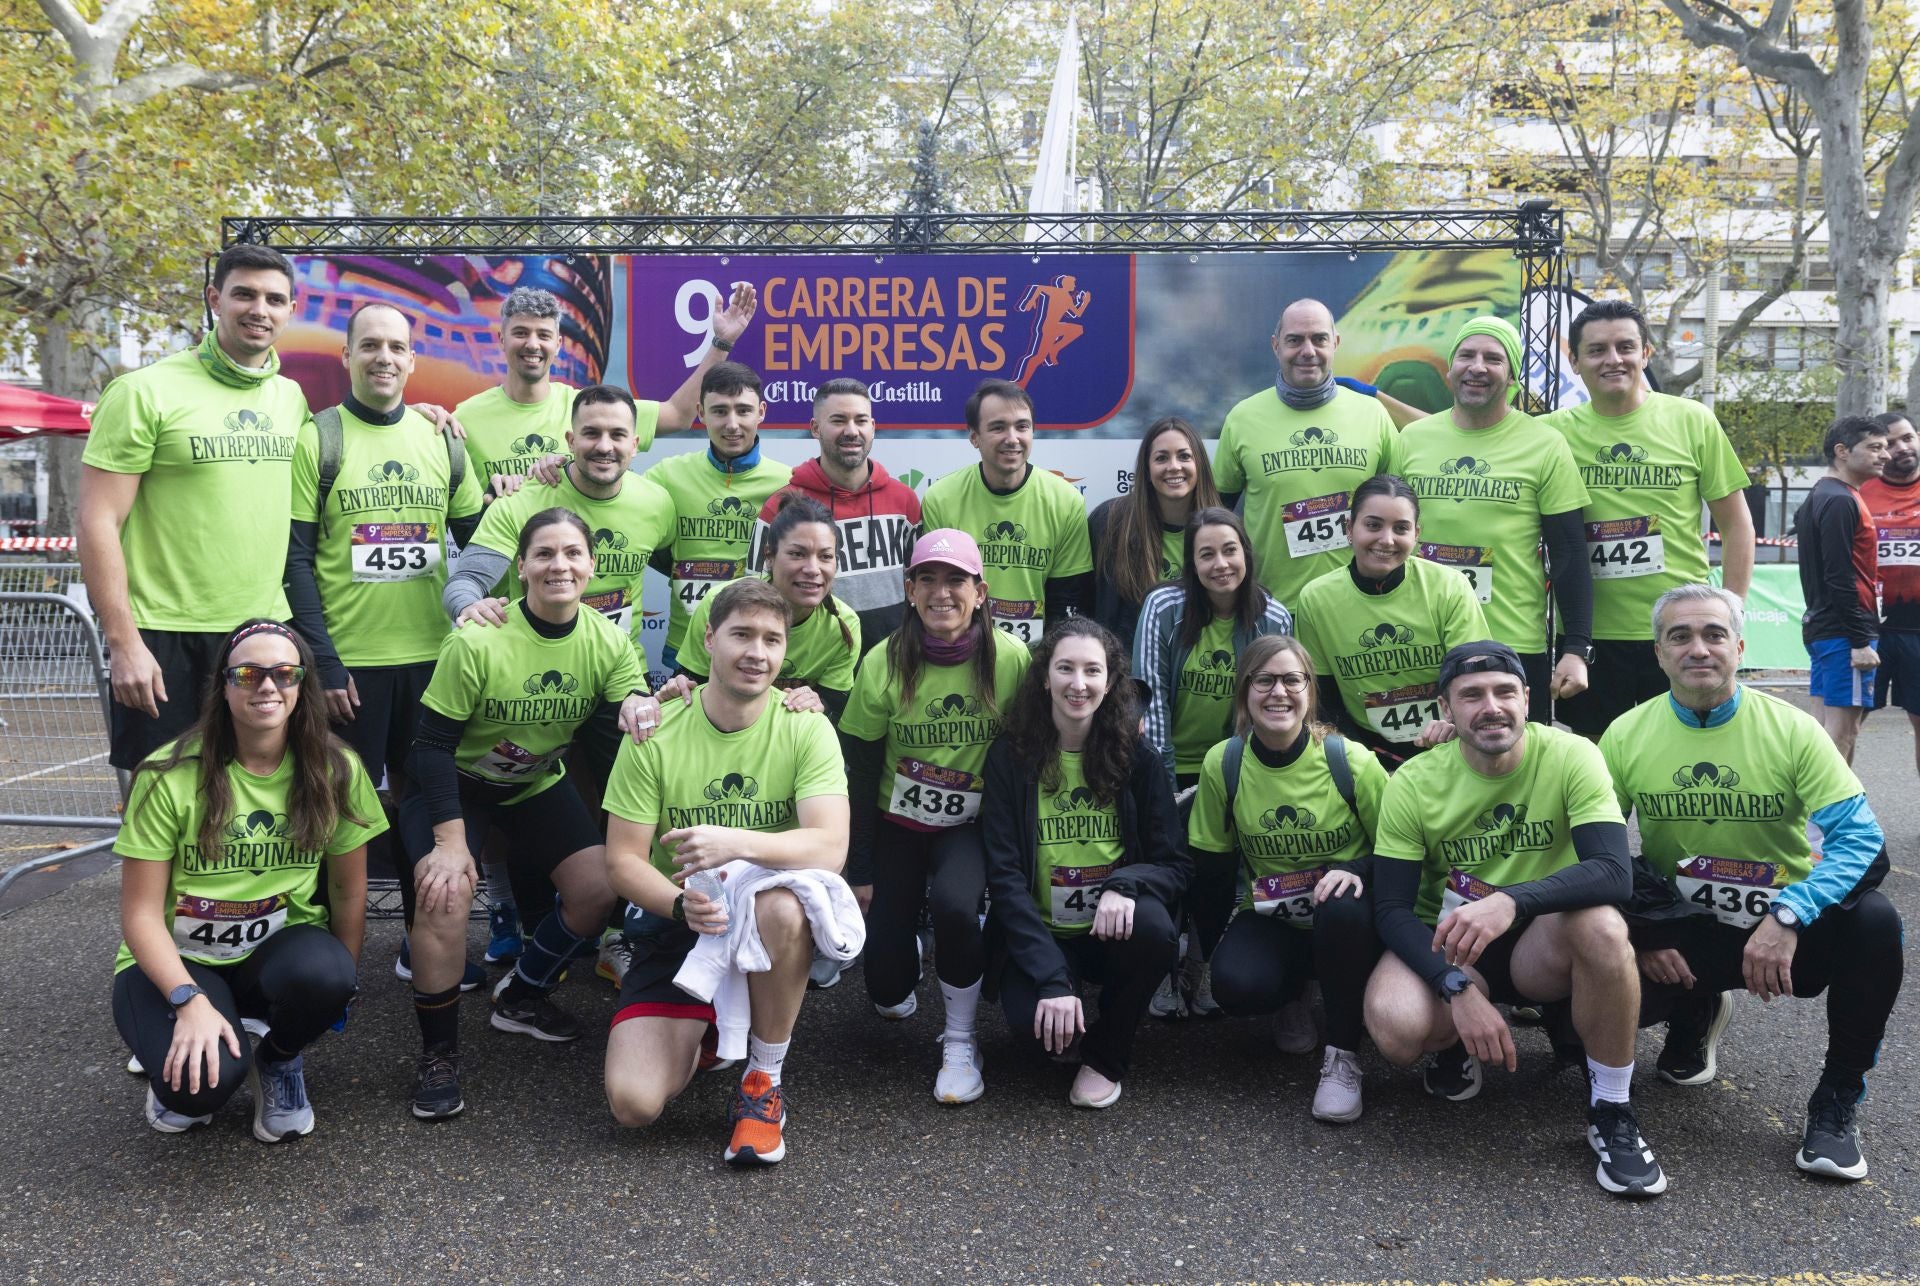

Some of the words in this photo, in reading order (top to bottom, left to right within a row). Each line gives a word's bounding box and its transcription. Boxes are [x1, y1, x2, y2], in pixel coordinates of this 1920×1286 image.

[763, 277, 945, 318] CARRERA
[957, 277, 1007, 317] DE
[764, 323, 1006, 371] EMPRESAS
[763, 381, 788, 403] El
[868, 381, 942, 403] Castilla
[1261, 447, 1368, 473] ENTREPINARES
[1297, 514, 1347, 543] 451
[365, 546, 427, 571] 453
[1591, 541, 1651, 567] 442
[1878, 542, 1920, 557] 552
[1744, 608, 1789, 626] nicaja
[1381, 702, 1440, 731] 441
[667, 797, 794, 829] ENTREPINARES
[903, 784, 965, 816] 438
[1638, 792, 1785, 817] ENTREPINARES
[1712, 860, 1743, 869] CARRERA
[1712, 866, 1753, 877] EMPRESAS
[1691, 883, 1770, 917] 436
[189, 918, 269, 947] 440
